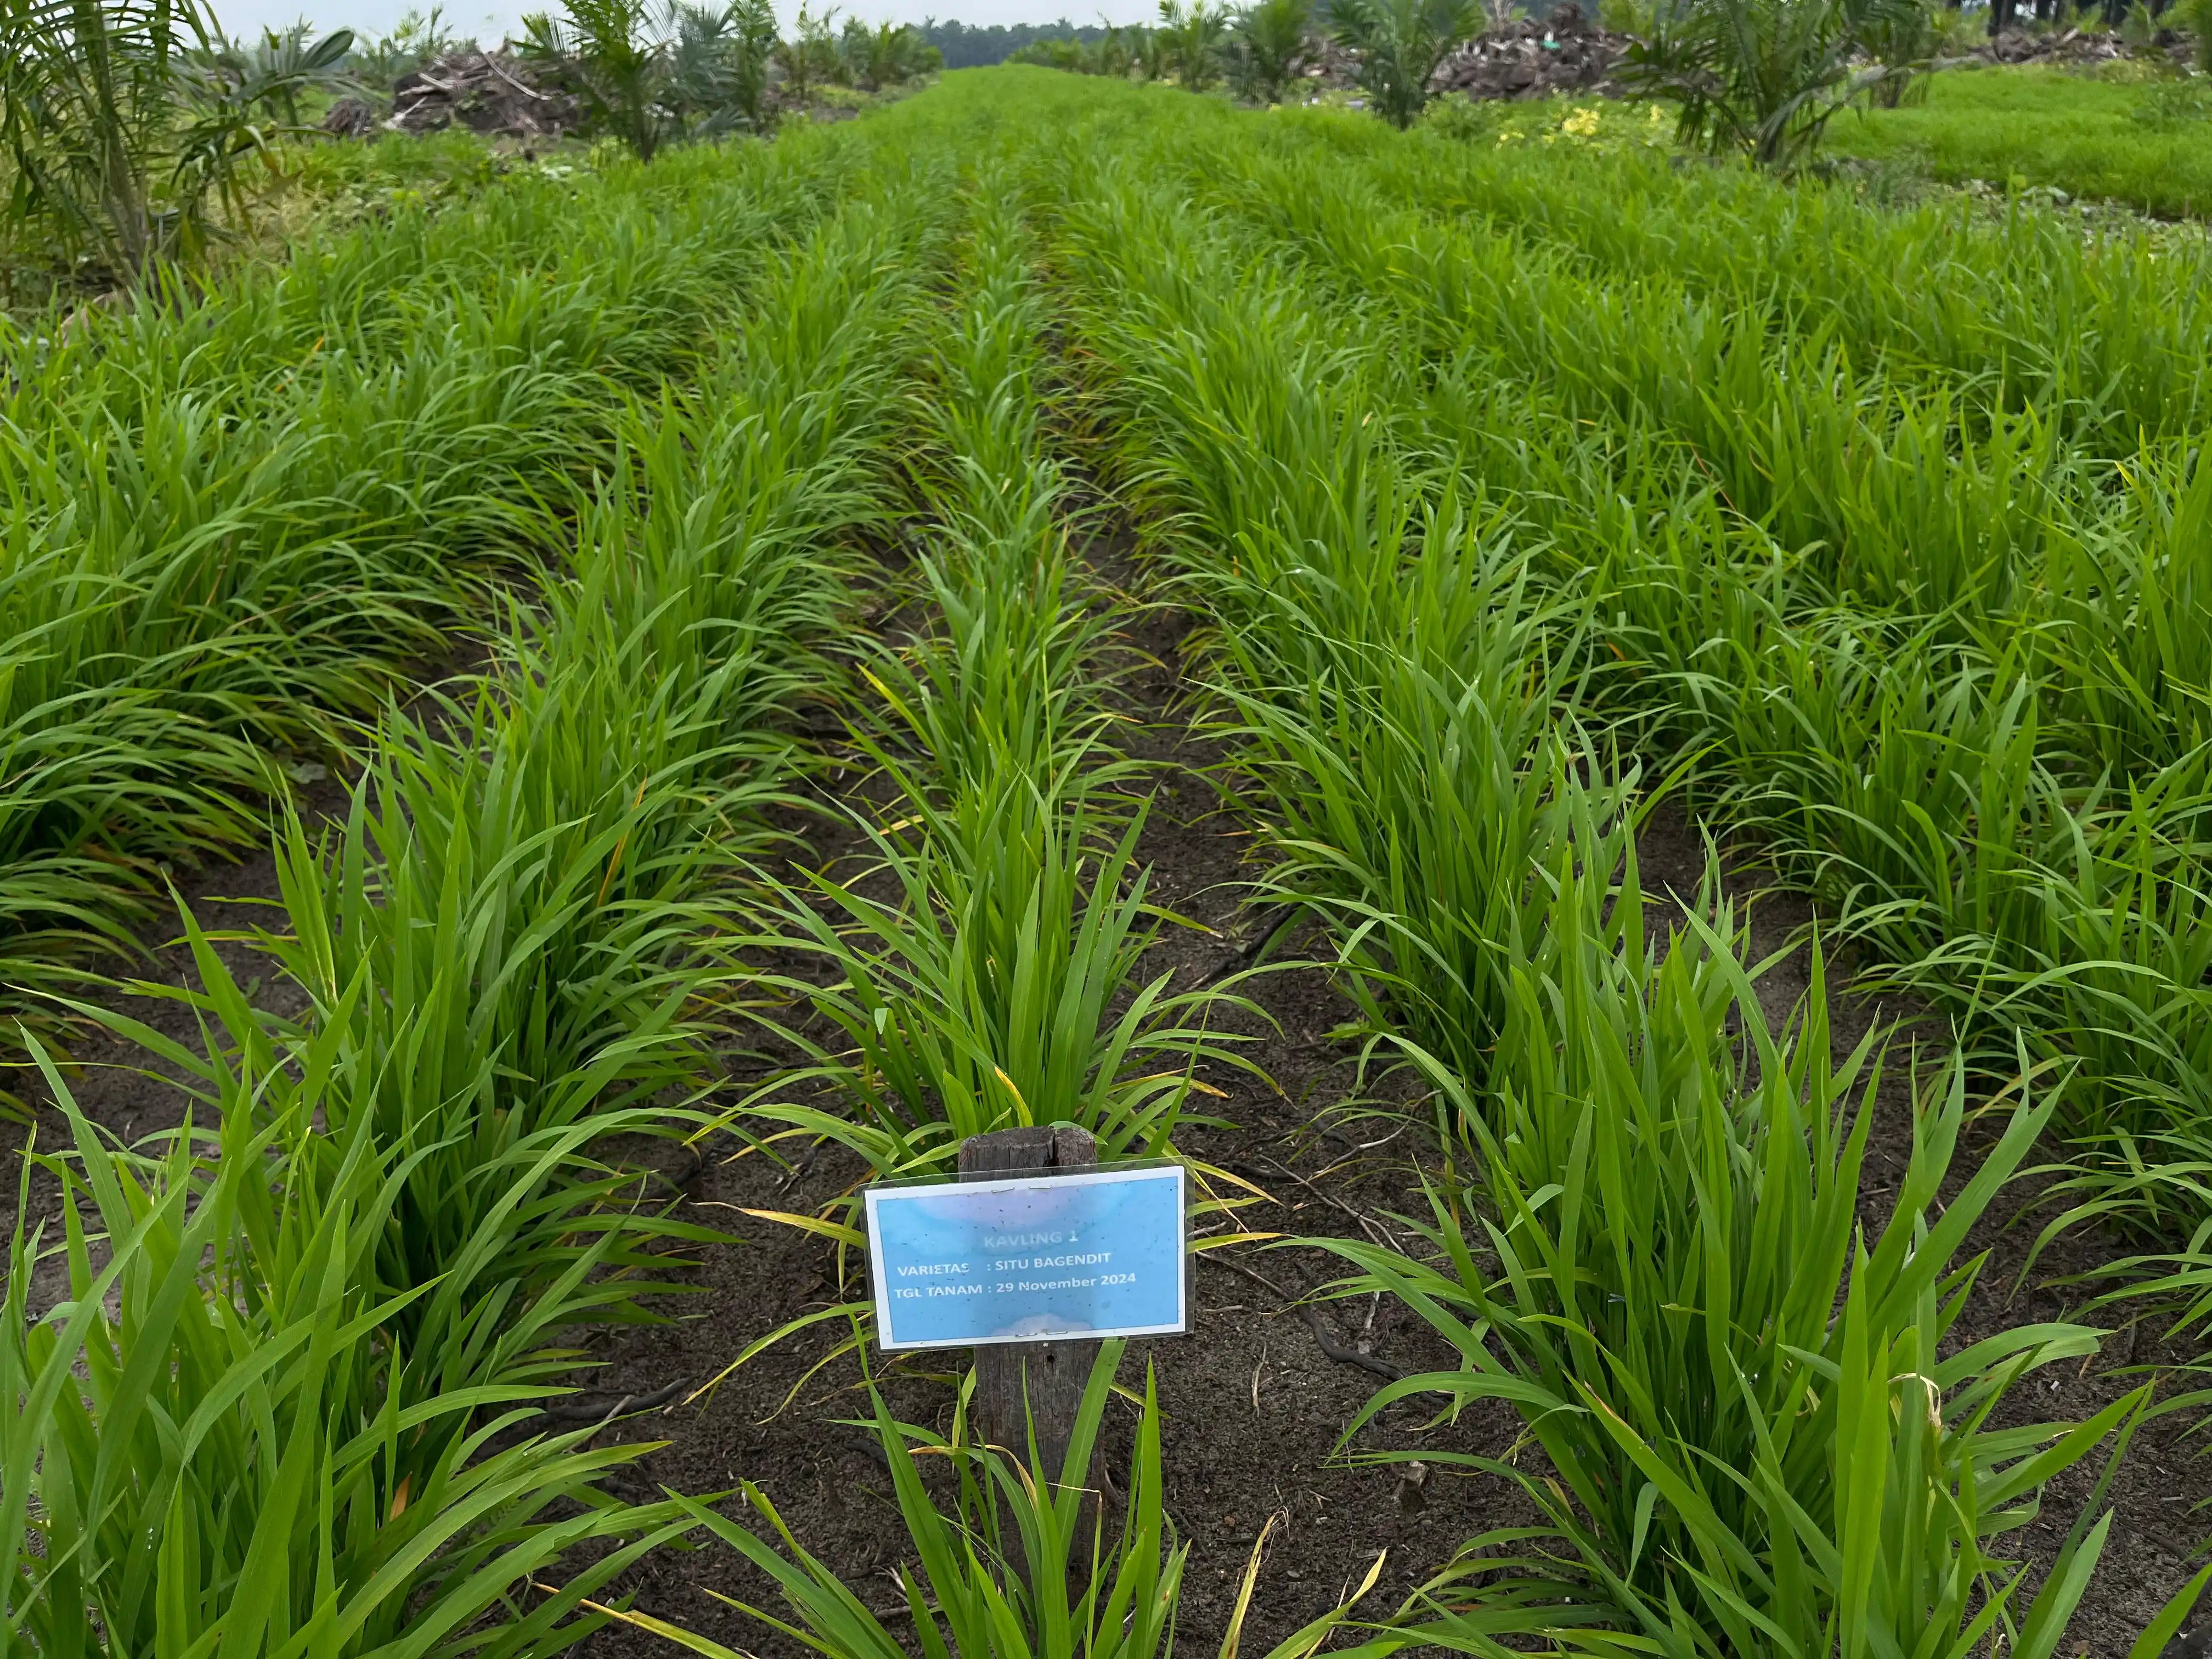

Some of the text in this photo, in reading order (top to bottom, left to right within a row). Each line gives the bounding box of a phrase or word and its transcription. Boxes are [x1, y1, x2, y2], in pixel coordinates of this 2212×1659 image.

[984, 1230, 1078, 1249] KAVLING 1
[897, 1262, 970, 1277] VARIETAS
[995, 1259, 1029, 1271] SITU
[1034, 1252, 1112, 1268] BAGENDIT
[894, 1288, 922, 1299] TGL
[924, 1284, 982, 1297] TANAM
[996, 1282, 1014, 1293] 29
[1019, 1277, 1096, 1292] November
[1101, 1272, 1137, 1286] 2024
